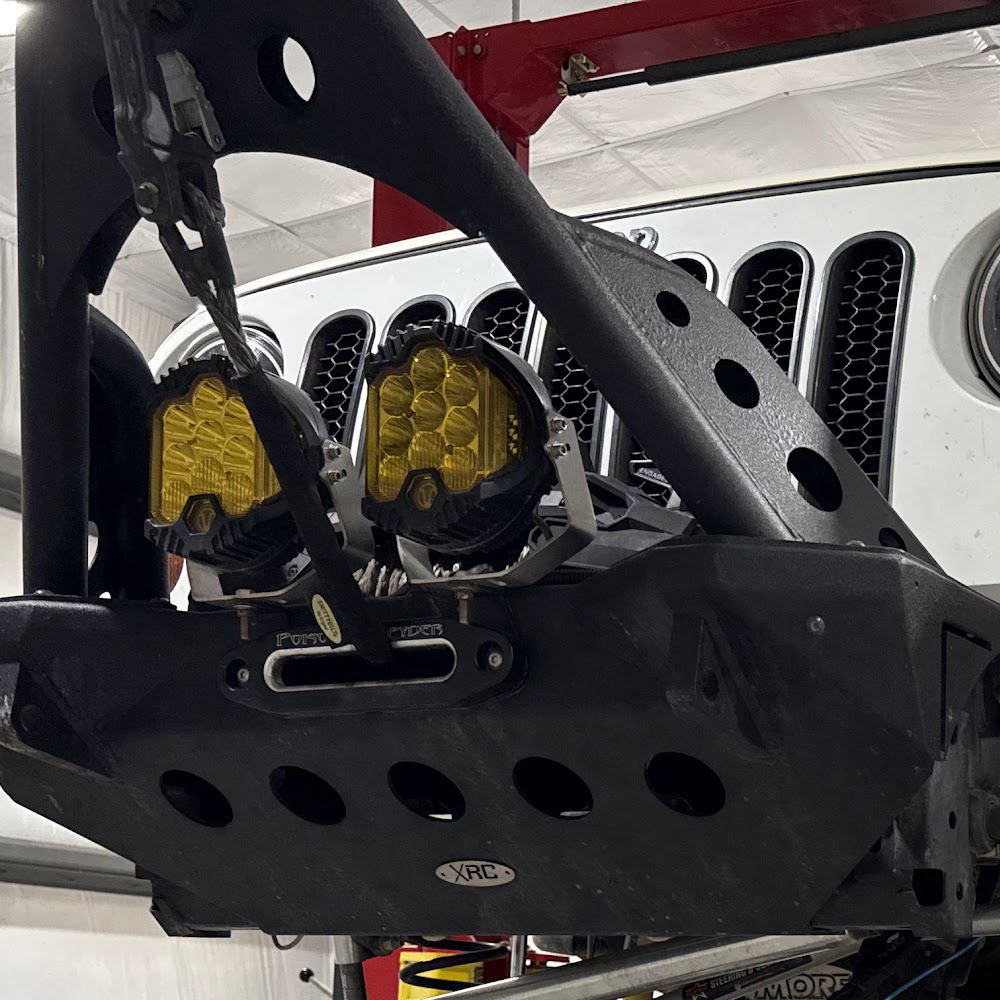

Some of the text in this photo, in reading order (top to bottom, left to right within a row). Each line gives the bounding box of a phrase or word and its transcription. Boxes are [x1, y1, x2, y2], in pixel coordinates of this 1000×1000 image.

[276, 623, 443, 646] POISO PYDER
[449, 863, 498, 882] XRC
